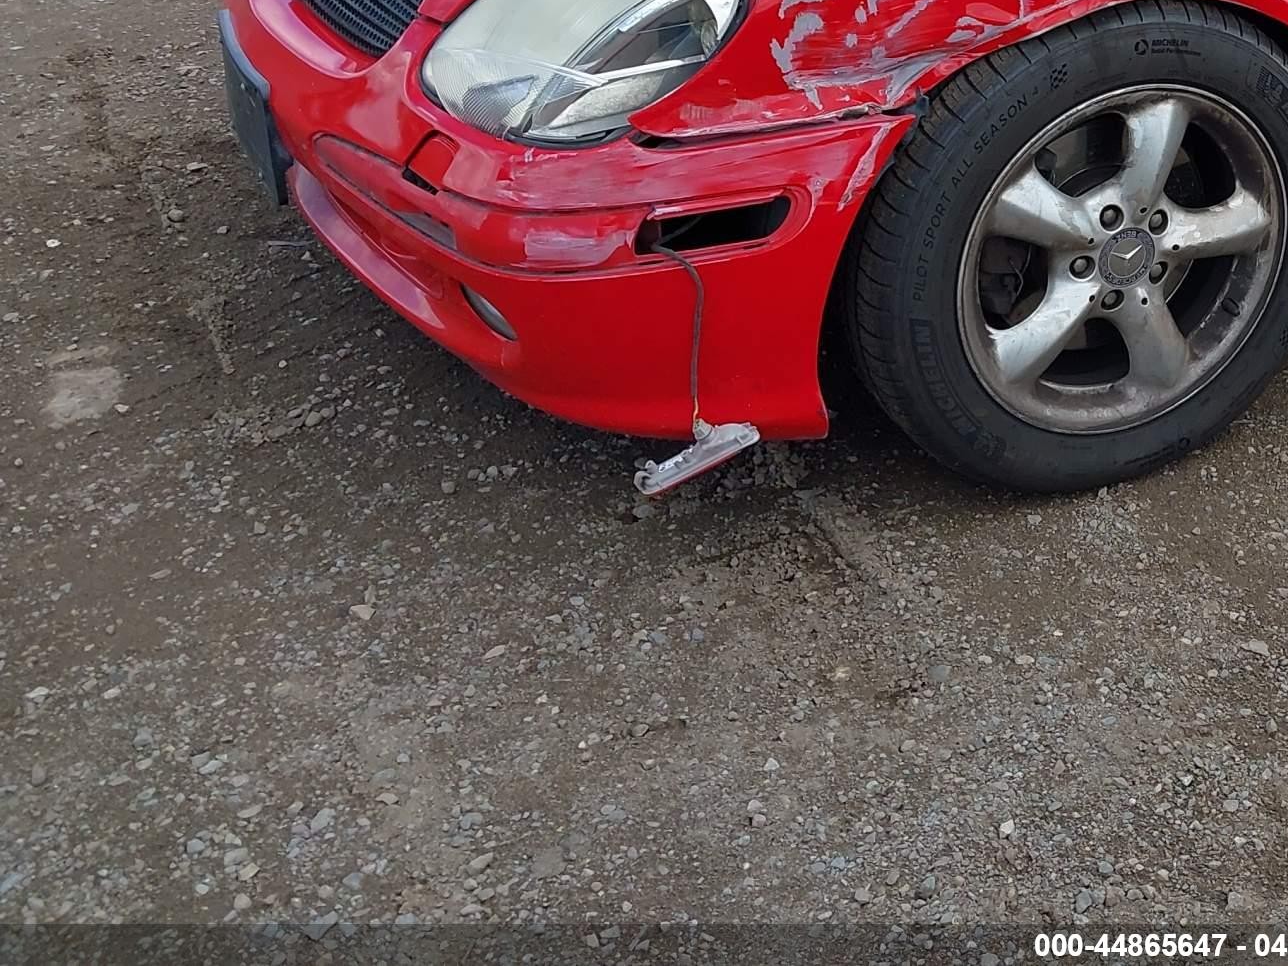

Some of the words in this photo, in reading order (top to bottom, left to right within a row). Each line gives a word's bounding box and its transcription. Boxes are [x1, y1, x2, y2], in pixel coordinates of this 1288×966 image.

[913, 257, 930, 303] PILOT
[922, 194, 953, 252] SPORT
[951, 160, 975, 191] ALL
[973, 92, 1029, 155] SEASON
